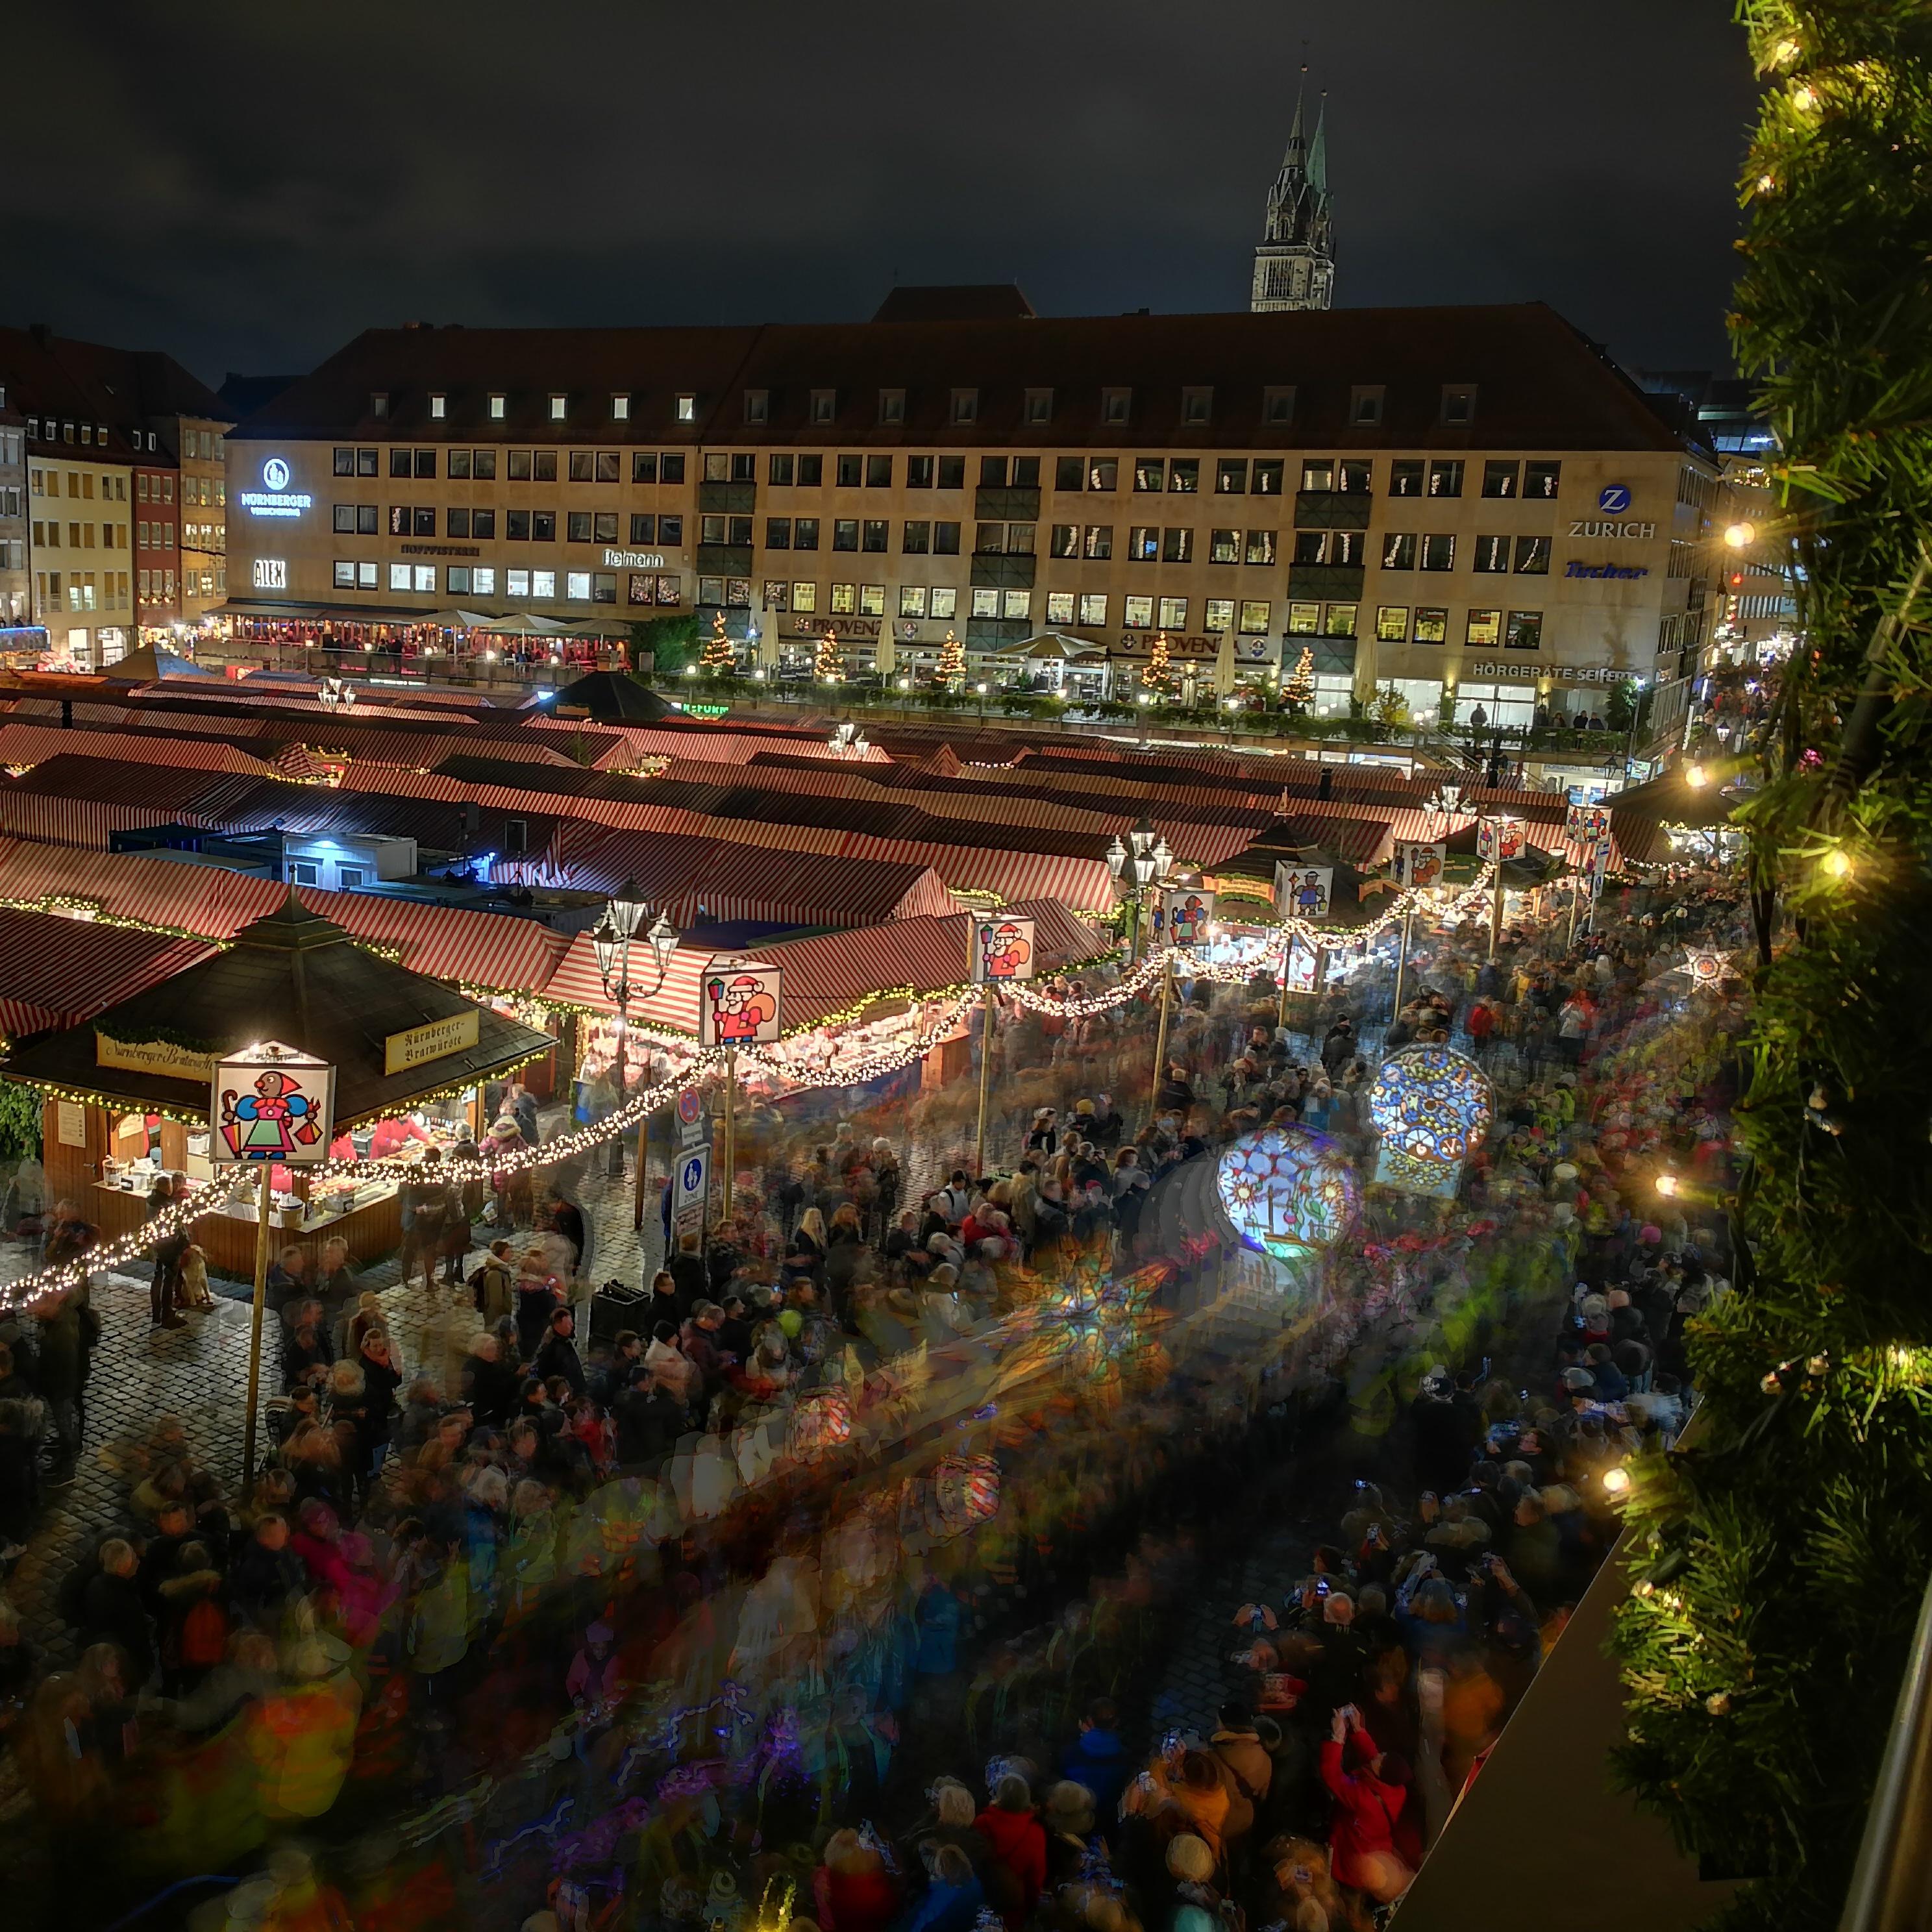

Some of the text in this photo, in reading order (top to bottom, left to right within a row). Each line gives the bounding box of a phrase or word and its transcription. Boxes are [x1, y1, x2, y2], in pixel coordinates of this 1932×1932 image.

[1600, 489, 1626, 510] Z
[1568, 521, 1655, 539] ZURICH
[254, 560, 286, 589] ALEX
[1564, 561, 1648, 580] Tucher
[812, 619, 897, 636] PROVENZ
[1473, 662, 1572, 680] HÖRGERÄTE
[404, 1035, 462, 1062] Bratwürste
